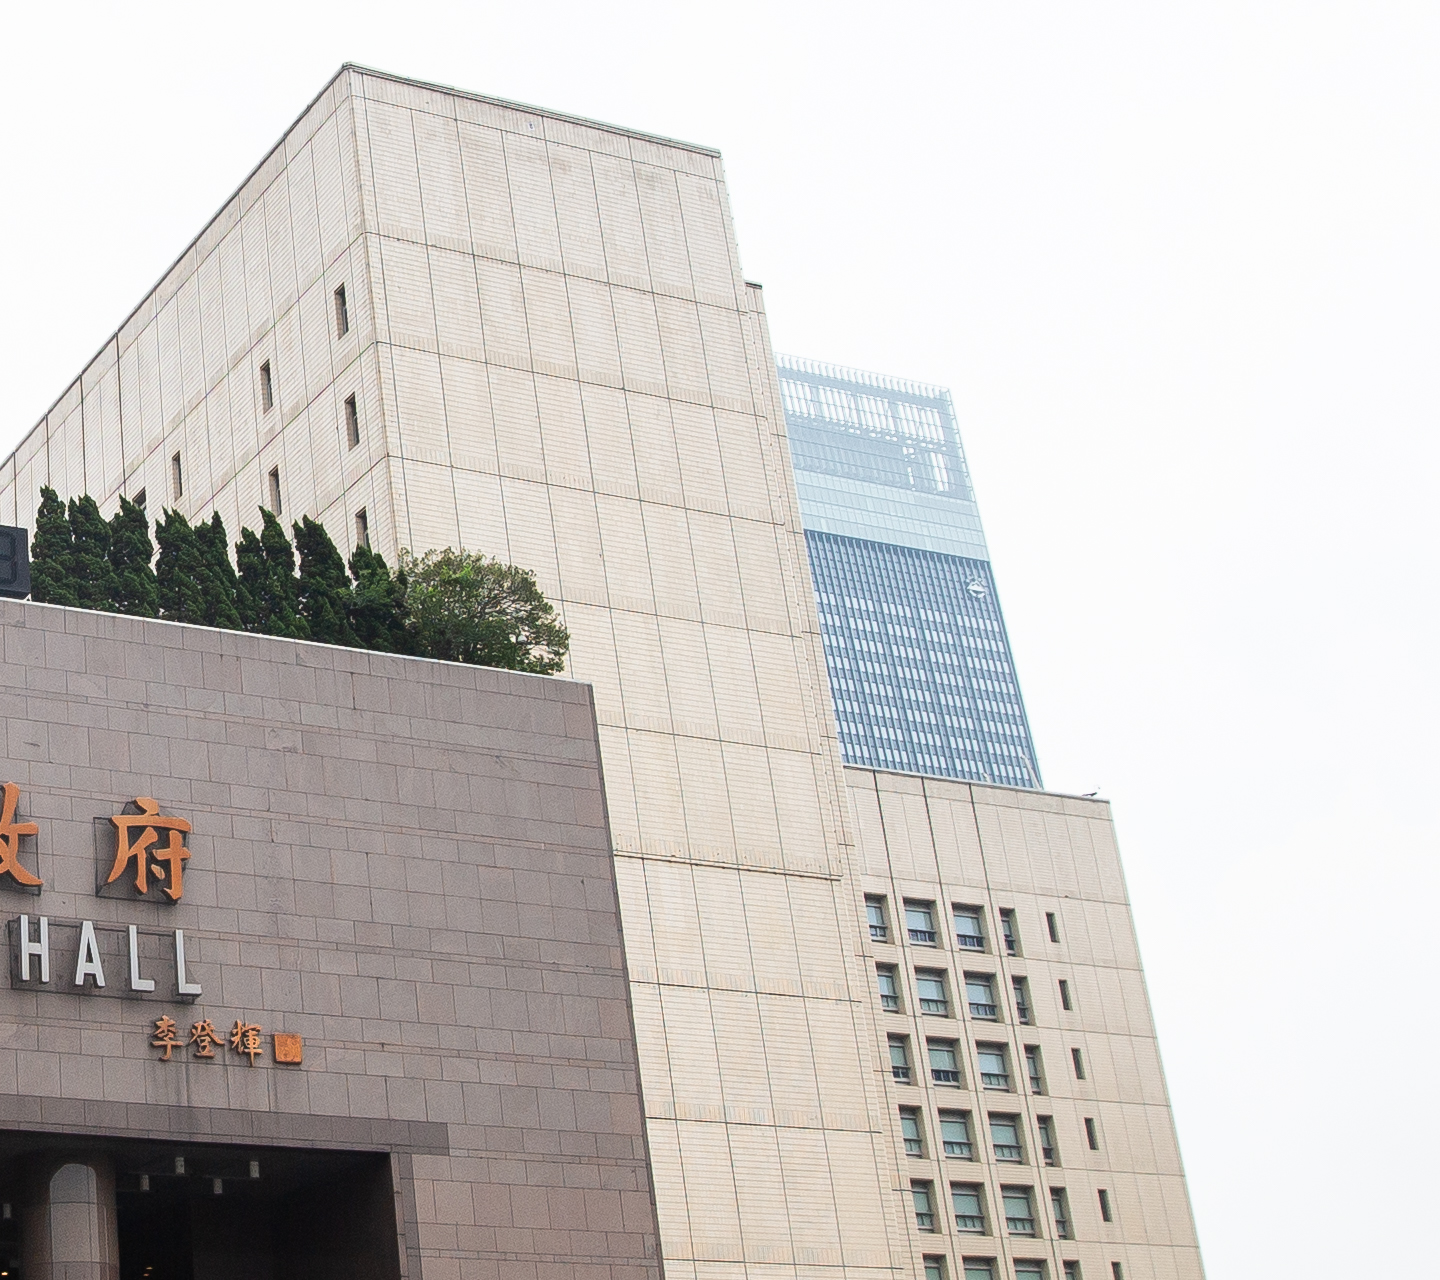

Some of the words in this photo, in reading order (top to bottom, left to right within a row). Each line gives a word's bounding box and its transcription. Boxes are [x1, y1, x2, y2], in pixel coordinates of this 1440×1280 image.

[19, 913, 203, 998] HALL
[149, 1014, 264, 1068] 李登輝
